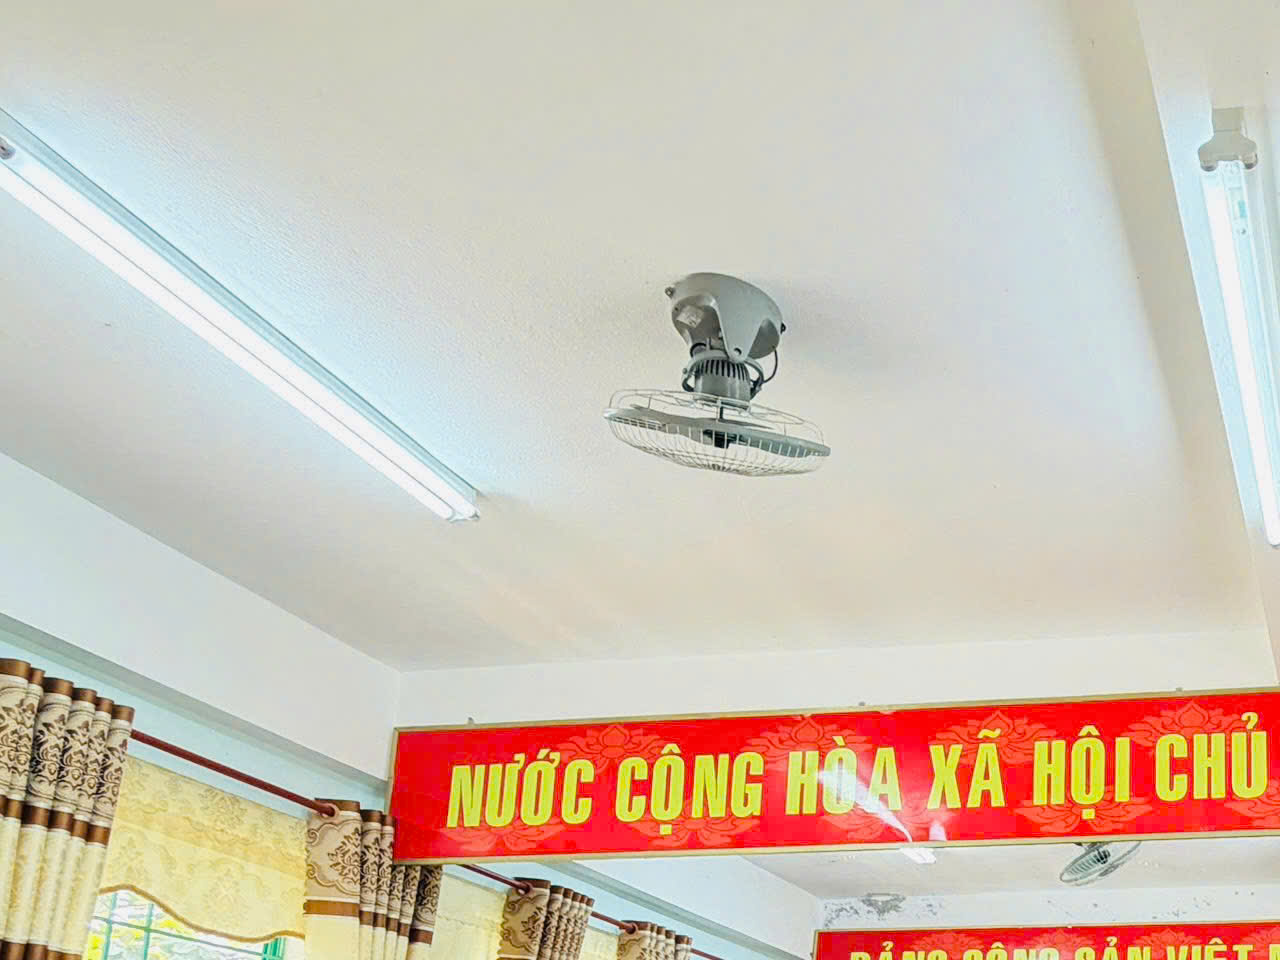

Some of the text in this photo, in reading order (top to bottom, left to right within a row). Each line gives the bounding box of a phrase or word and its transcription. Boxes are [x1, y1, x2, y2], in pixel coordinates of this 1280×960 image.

[446, 749, 595, 828] NƯỚC
[615, 743, 765, 836] CỘNG
[785, 735, 905, 816] HÒA
[926, 728, 1005, 809] XÃ
[1032, 723, 1132, 820] HỘI
[1155, 711, 1269, 802] CHỦ
